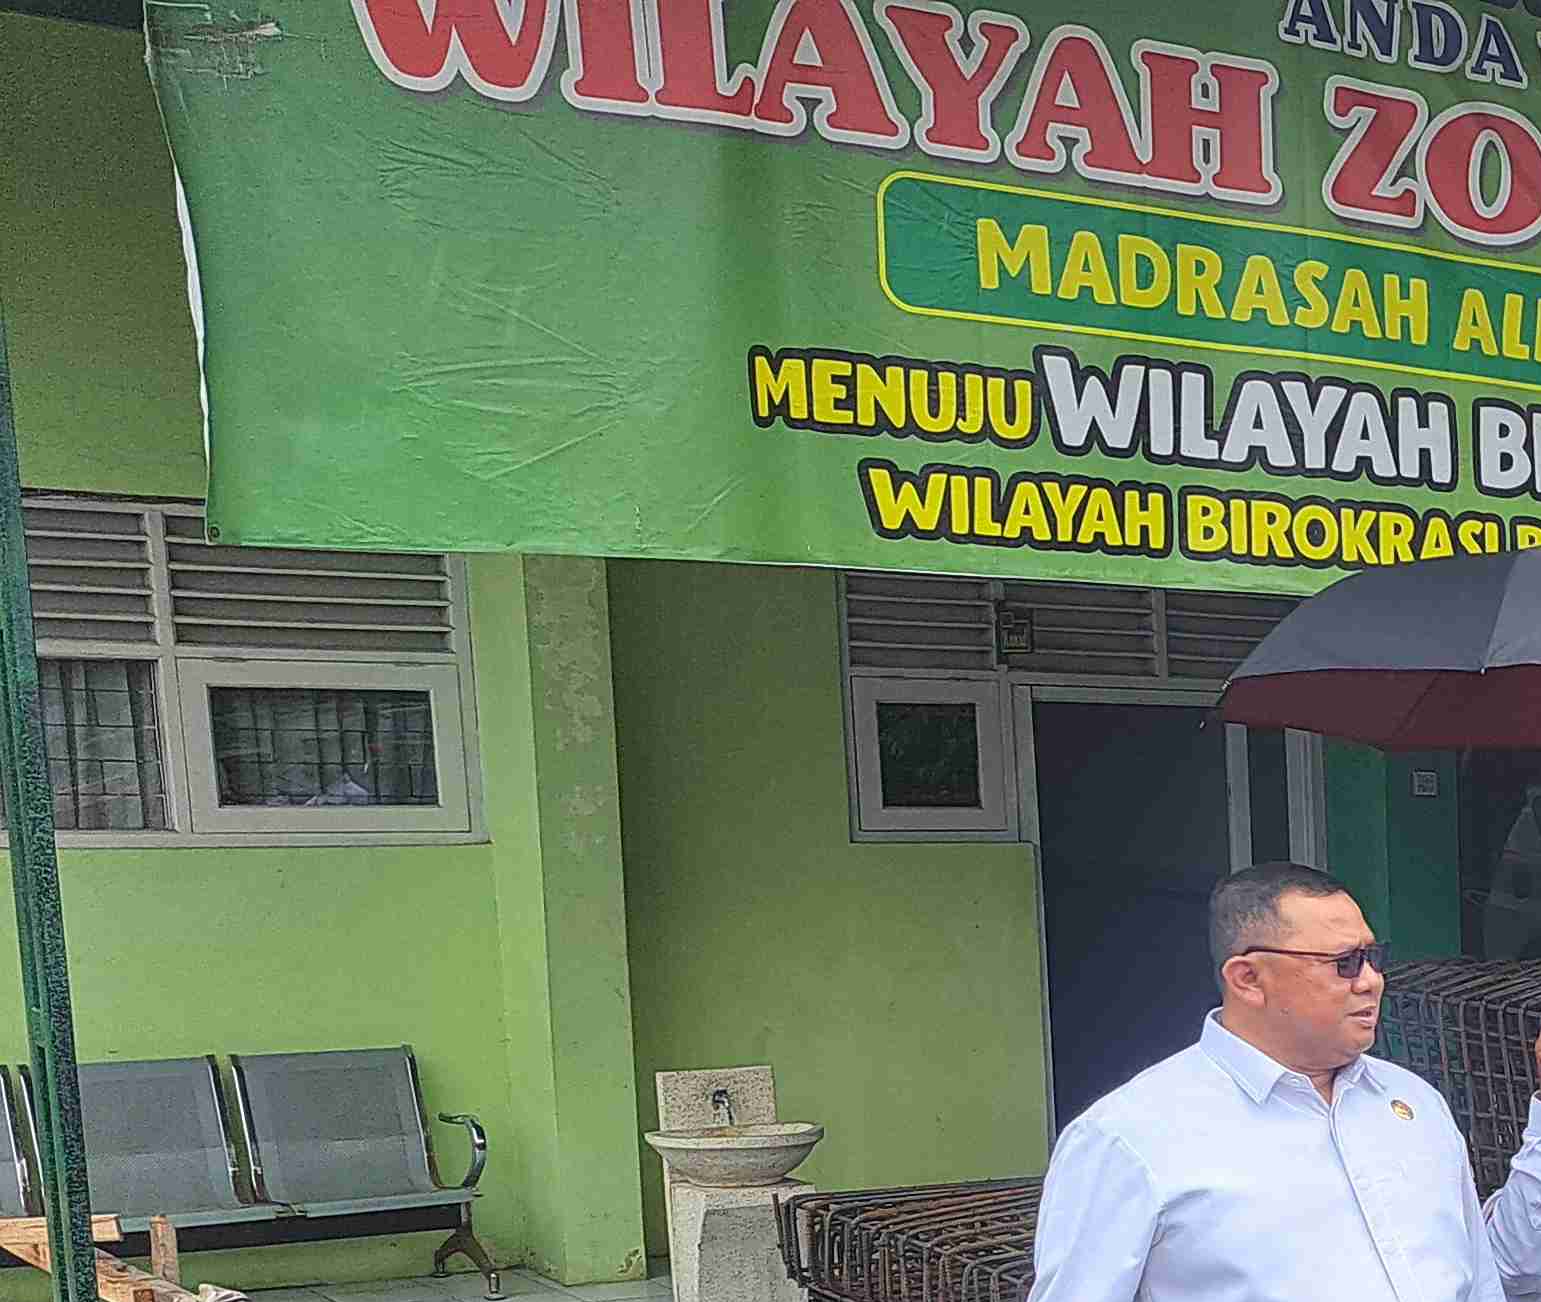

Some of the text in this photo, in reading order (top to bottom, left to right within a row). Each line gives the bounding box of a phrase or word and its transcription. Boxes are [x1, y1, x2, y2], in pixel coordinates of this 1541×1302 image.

[353, 0, 1282, 204] WILAYAH
[1282, 0, 1526, 87] ANDA
[977, 219, 1429, 345] MADRASAH
[753, 356, 1032, 439] MENUJU
[1041, 355, 1452, 484] WILAYAH
[869, 467, 1166, 550] WILAYAH
[1187, 493, 1499, 566] BIROKRASI
